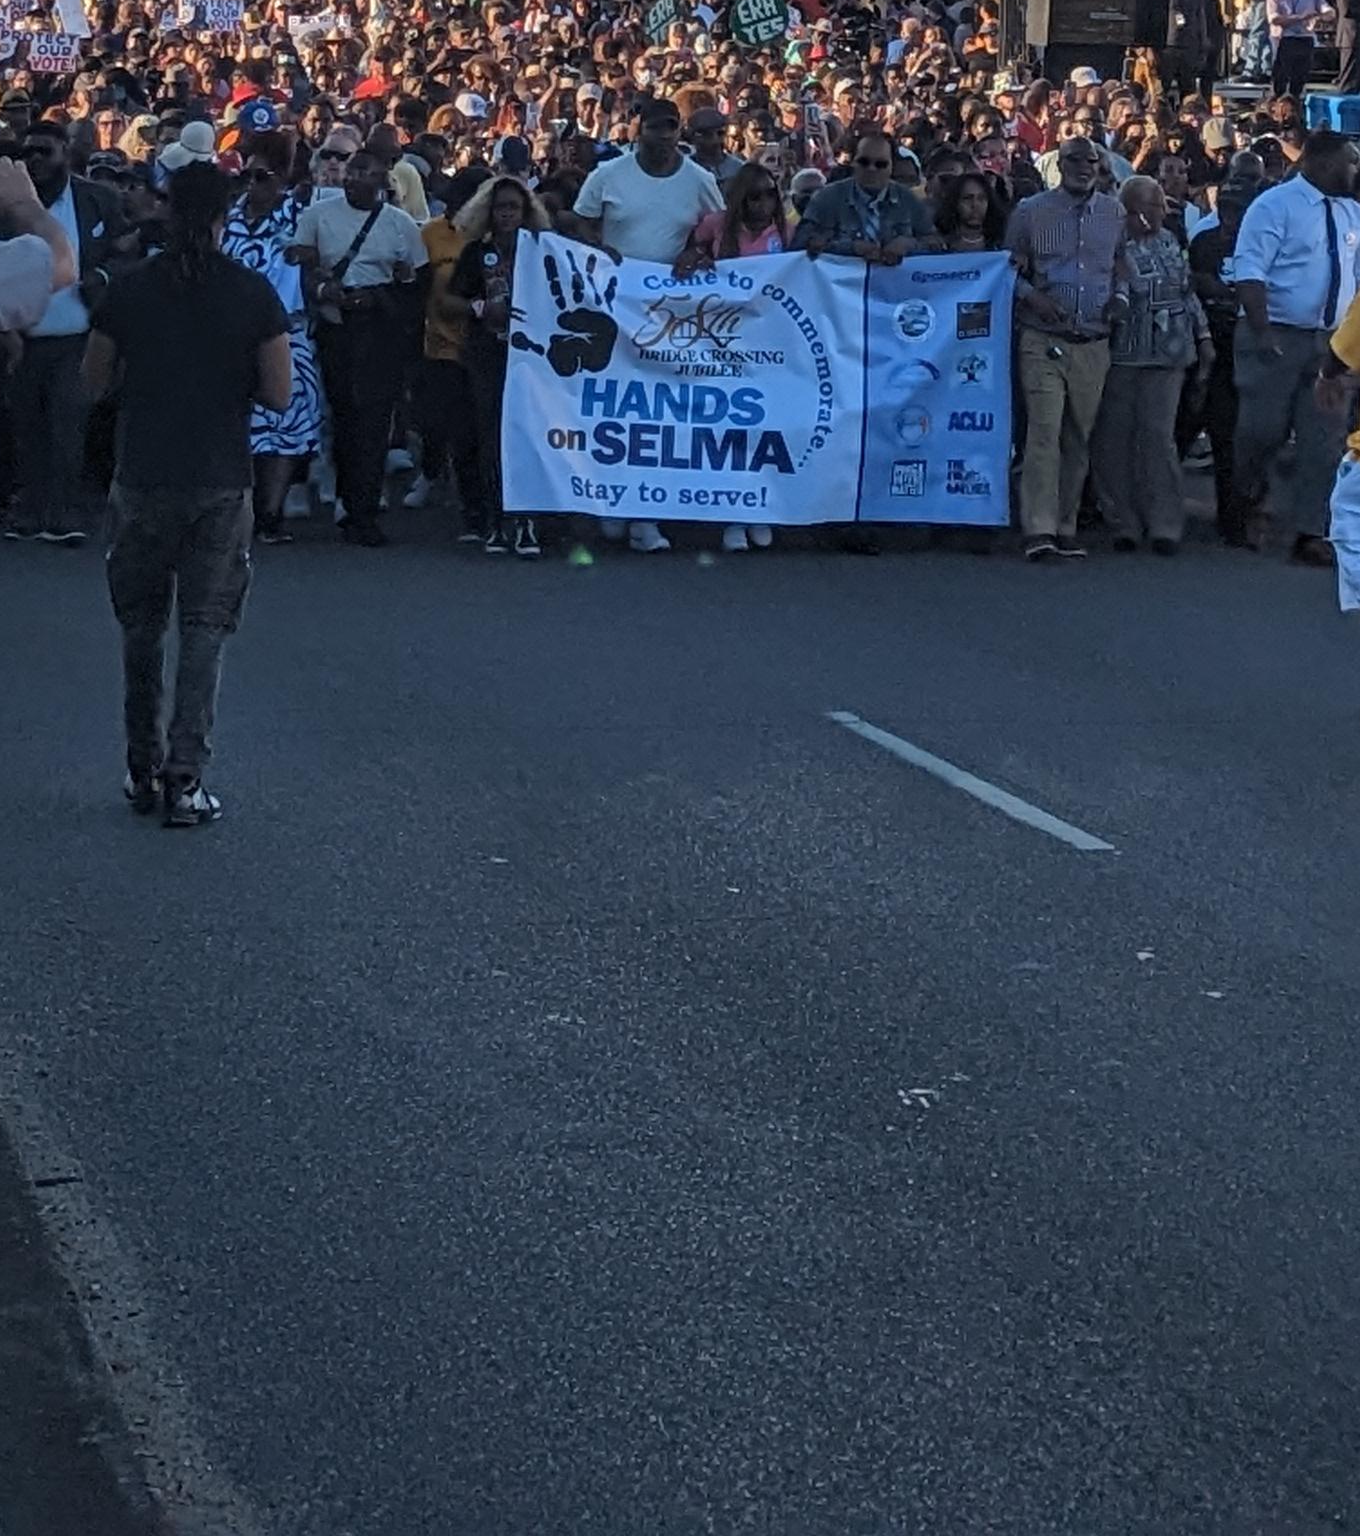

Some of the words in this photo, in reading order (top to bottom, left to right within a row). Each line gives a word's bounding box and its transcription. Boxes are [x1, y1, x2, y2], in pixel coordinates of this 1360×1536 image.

[0, 29, 78, 47] PROTECT
[742, 16, 785, 44] YES
[36, 44, 73, 57] OUR
[31, 55, 76, 72] VOTE!
[727, 270, 754, 291] to
[640, 348, 697, 363] BRIDGE
[700, 349, 785, 365] CROSSING
[674, 364, 743, 378] JUBILEE
[580, 378, 766, 426] HANDS
[947, 411, 994, 432] ACLU
[547, 427, 587, 452] on
[590, 420, 797, 475] SELMA
[570, 475, 628, 507] Stay
[639, 482, 668, 504] to
[678, 486, 769, 508] serve!
